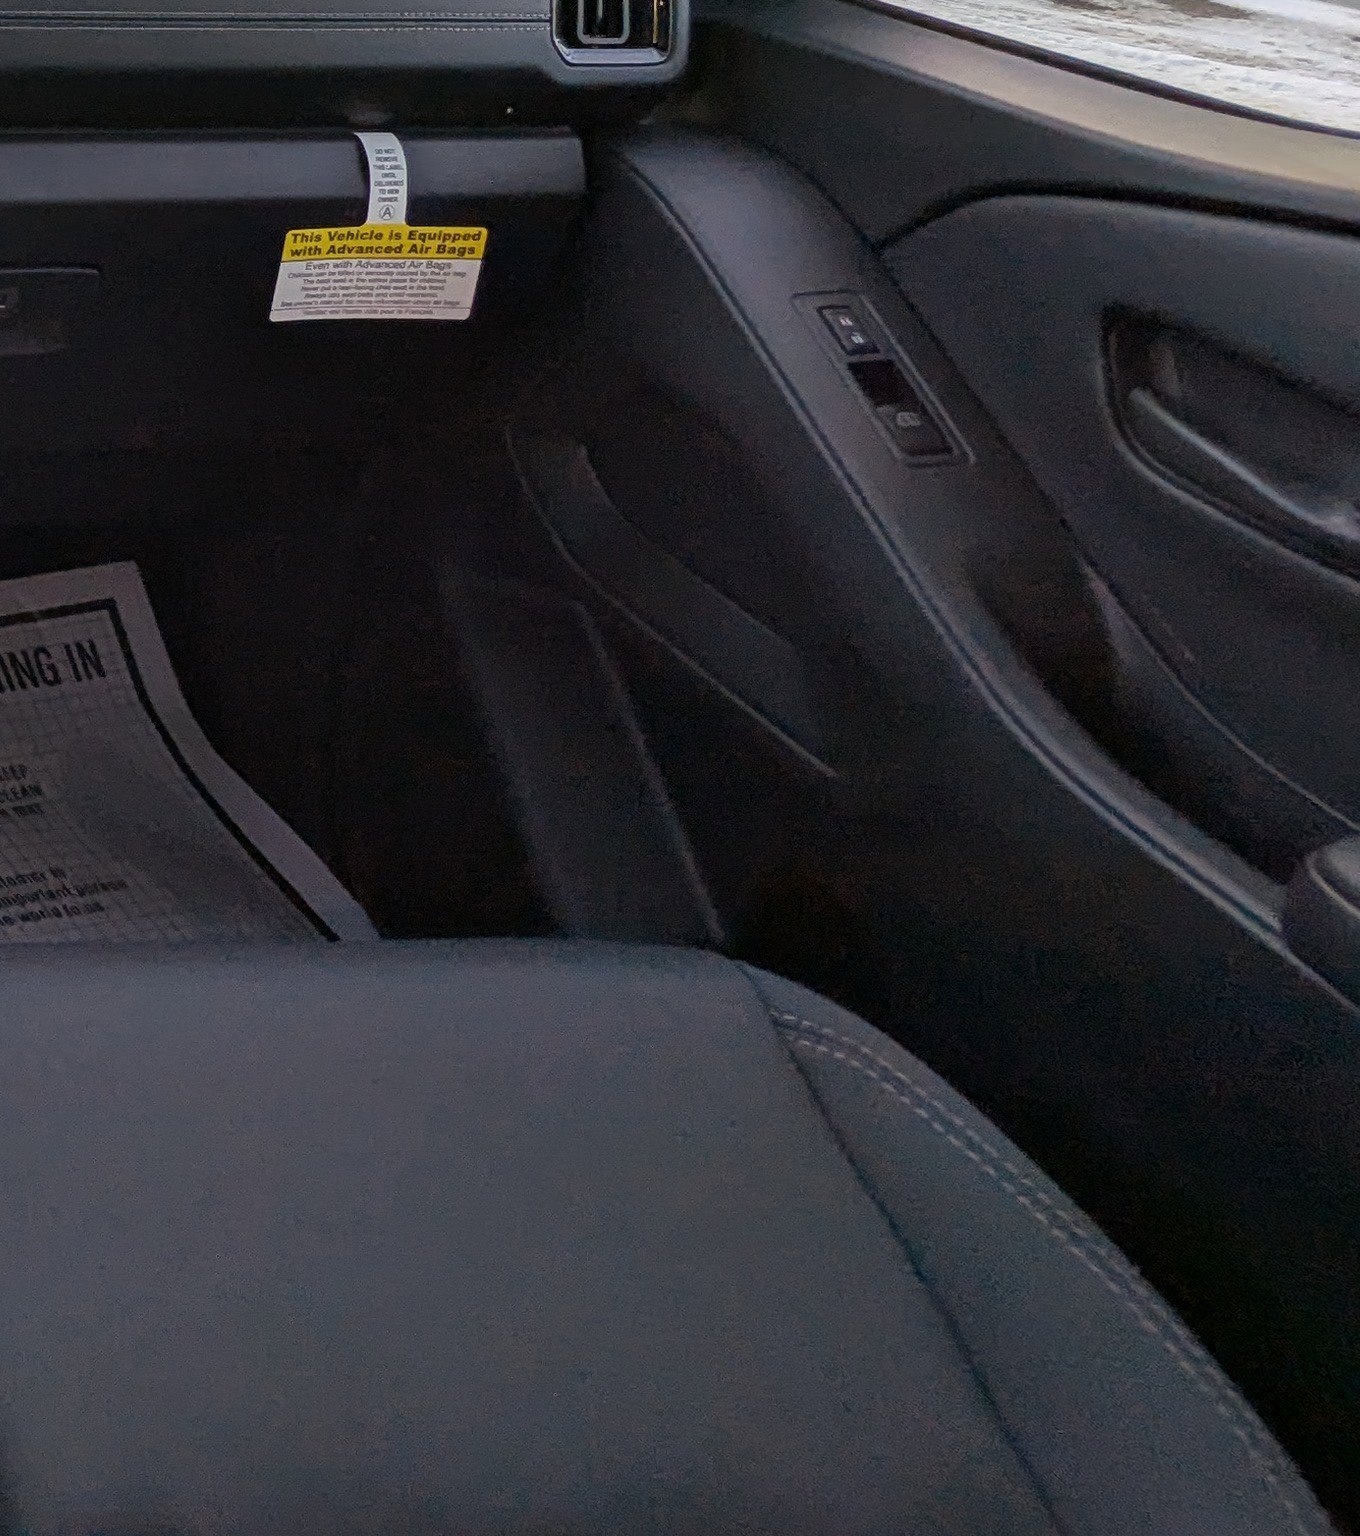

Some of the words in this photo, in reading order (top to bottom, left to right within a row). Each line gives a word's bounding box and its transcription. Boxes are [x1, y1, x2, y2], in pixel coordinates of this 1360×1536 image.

[290, 232, 322, 244] This
[327, 230, 384, 242] Vehicle
[388, 230, 402, 241] is
[407, 230, 482, 244] Equipped
[289, 245, 322, 257] with
[325, 244, 404, 255] Advanced
[407, 244, 431, 255] Air
[434, 244, 476, 257] Bags
[304, 261, 330, 270] Even
[355, 260, 406, 270] Advanced
[408, 261, 423, 270] Air
[68, 637, 108, 683] IN
